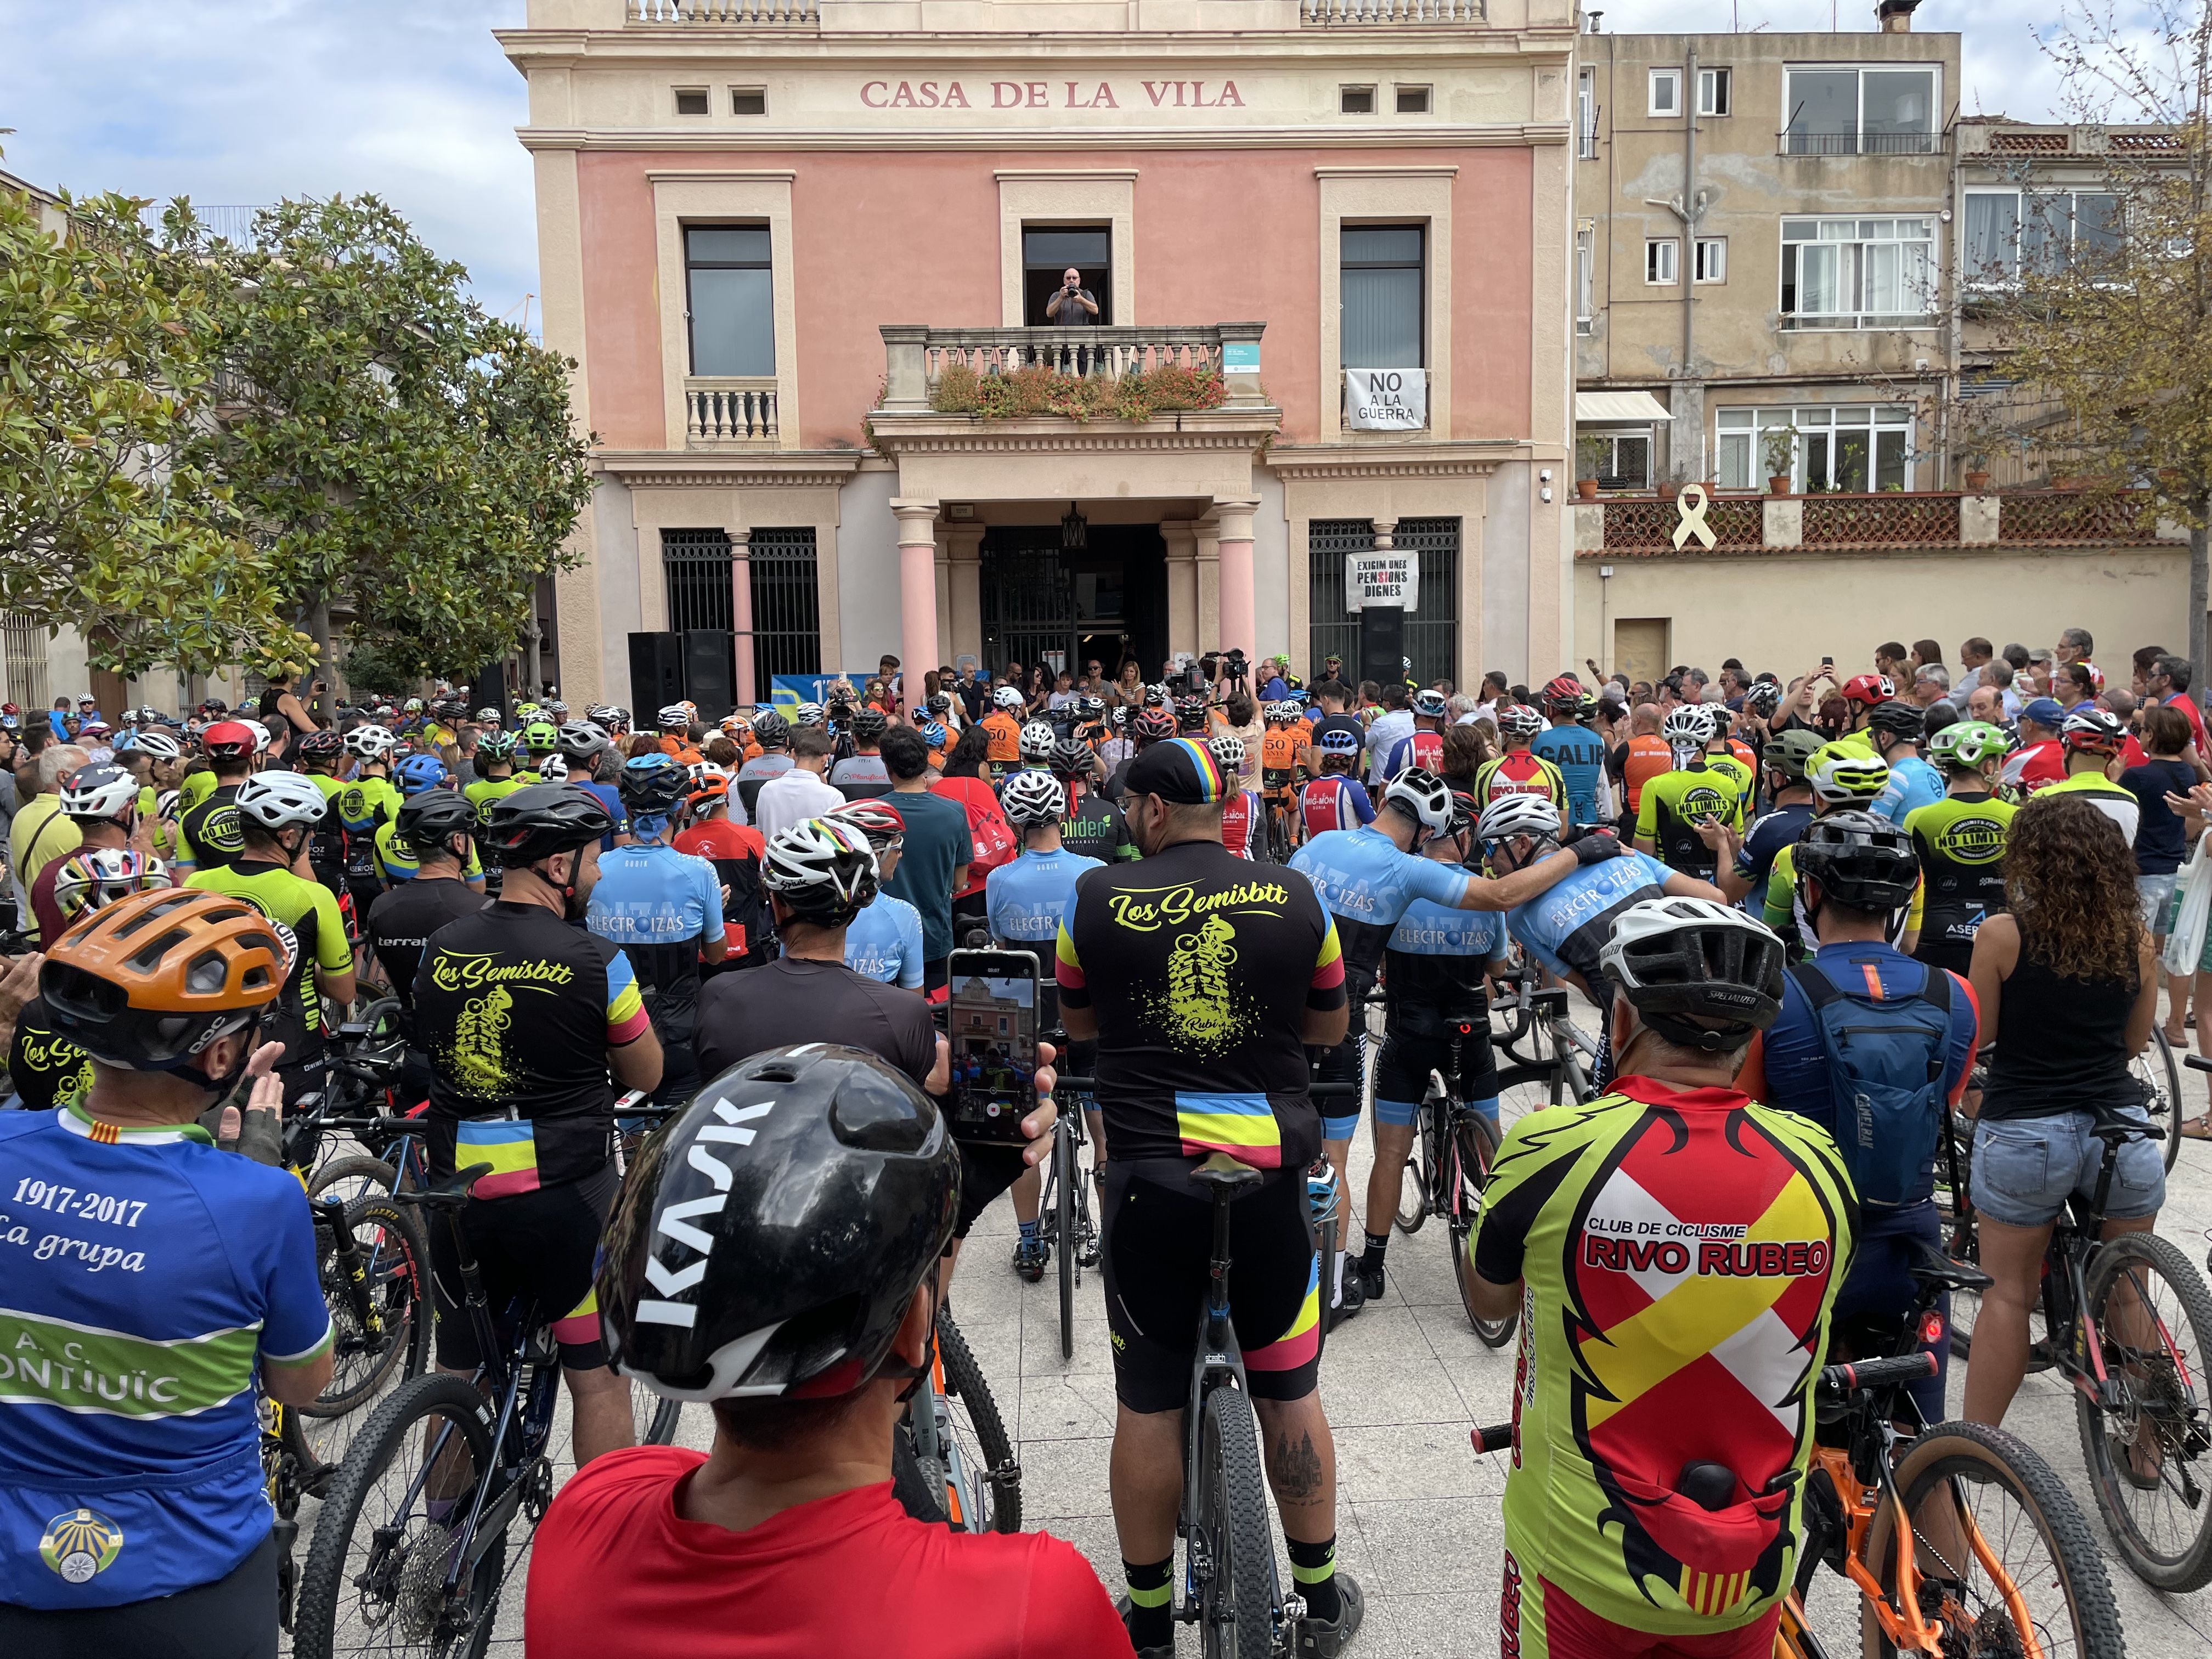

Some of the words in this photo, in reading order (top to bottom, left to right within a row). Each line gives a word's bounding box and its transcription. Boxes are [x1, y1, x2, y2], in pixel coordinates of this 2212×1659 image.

[860, 80, 971, 109] CASA
[991, 81, 1049, 109] DE
[1064, 81, 1120, 109] LA
[1141, 80, 1246, 108] VILA
[1370, 373, 1402, 392] NO
[1371, 394, 1379, 406] A
[1385, 394, 1401, 406] LA
[1359, 408, 1414, 419] GUERRA
[1358, 560, 1386, 571] EXIGIM
[1389, 560, 1407, 569] UNES
[1357, 571, 1408, 584] PENSIONS
[1365, 584, 1401, 597] DIGNES
[1265, 739, 1285, 750] 50
[1491, 785, 1514, 795] RIVO
[1516, 785, 1550, 795] RUBEO
[348, 798, 365, 806] LIMITS
[1678, 804, 1692, 814] NO
[1696, 800, 1728, 811] LIMITS
[1222, 811, 1245, 820] G-MÓN
[201, 827, 217, 840] NO
[219, 821, 241, 834] LIM
[1061, 815, 1106, 838] olideo
[386, 841, 396, 849] NO
[1938, 837, 1957, 848] NO
[1962, 832, 2006, 845] LIMIT
[1109, 895, 1162, 932] Los
[1160, 880, 1288, 924] Semisbtt
[300, 957, 317, 1006] LIMITS
[432, 956, 460, 991] Los
[462, 957, 574, 989] Semisbtt
[1706, 990, 1758, 1006] SPECIALIZED
[306, 1009, 320, 1031] NO
[1185, 1017, 1219, 1032] Rubí
[188, 1016, 226, 1054] POC
[22, 1036, 50, 1071] Los
[1855, 1093, 1874, 1149] CAMELBAK
[12, 1177, 148, 1227] 1917-2017
[635, 1097, 776, 1328] KASK
[1589, 1217, 1634, 1233] CLUB
[1638, 1222, 1661, 1235] DE
[1664, 1223, 1748, 1239] CICLISME
[33, 1234, 146, 1273] grupa
[1585, 1235, 1691, 1274] RIVO
[1698, 1241, 1830, 1278] RUBEO
[1527, 1325, 1535, 1345] DE
[15, 1331, 44, 1352] A.
[64, 1342, 91, 1364] C.
[1205, 1353, 1226, 1362] stealth
[0, 1353, 179, 1402] ONTJUÏC
[1526, 1346, 1536, 1408] CICLISME
